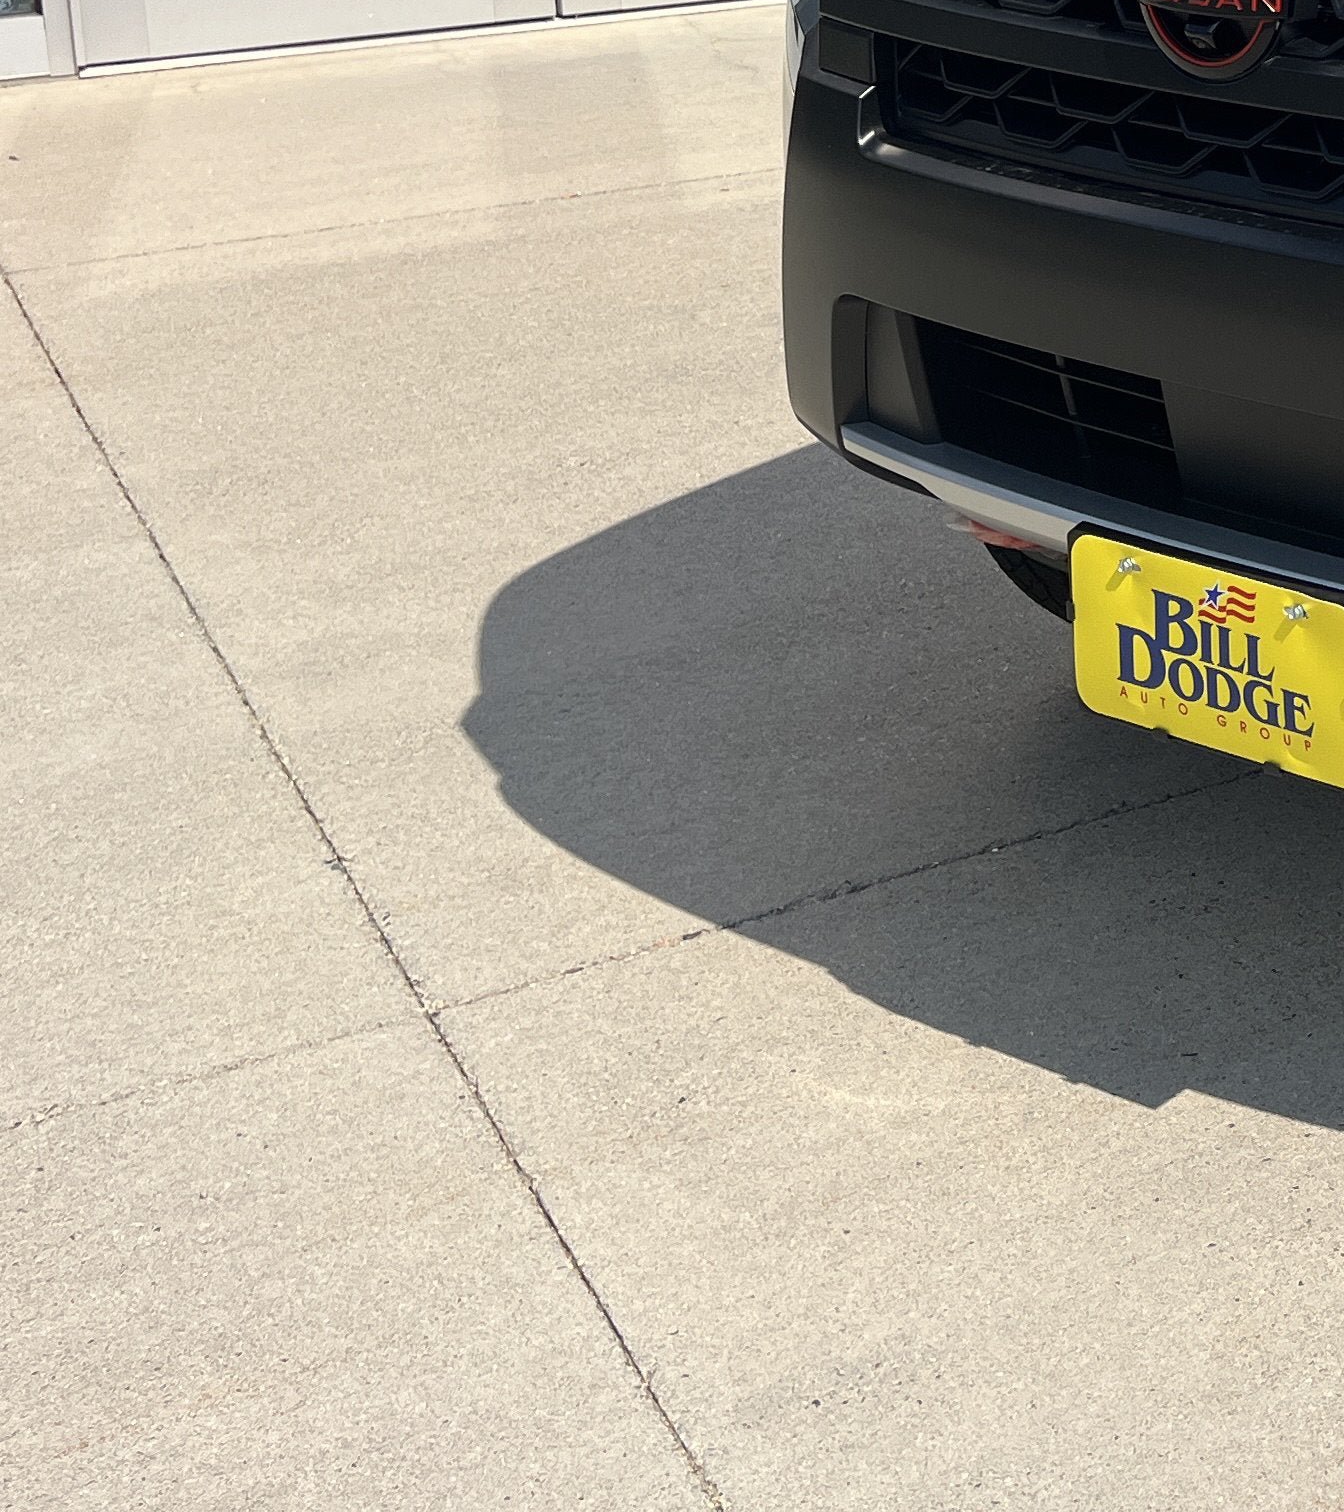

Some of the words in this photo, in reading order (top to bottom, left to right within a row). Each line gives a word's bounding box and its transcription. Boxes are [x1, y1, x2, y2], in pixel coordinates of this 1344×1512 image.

[1116, 622, 1315, 738] DODGE
[1151, 589, 1276, 682] BILL
[1119, 685, 1189, 716] AUTO
[1216, 714, 1313, 752] GROUP
